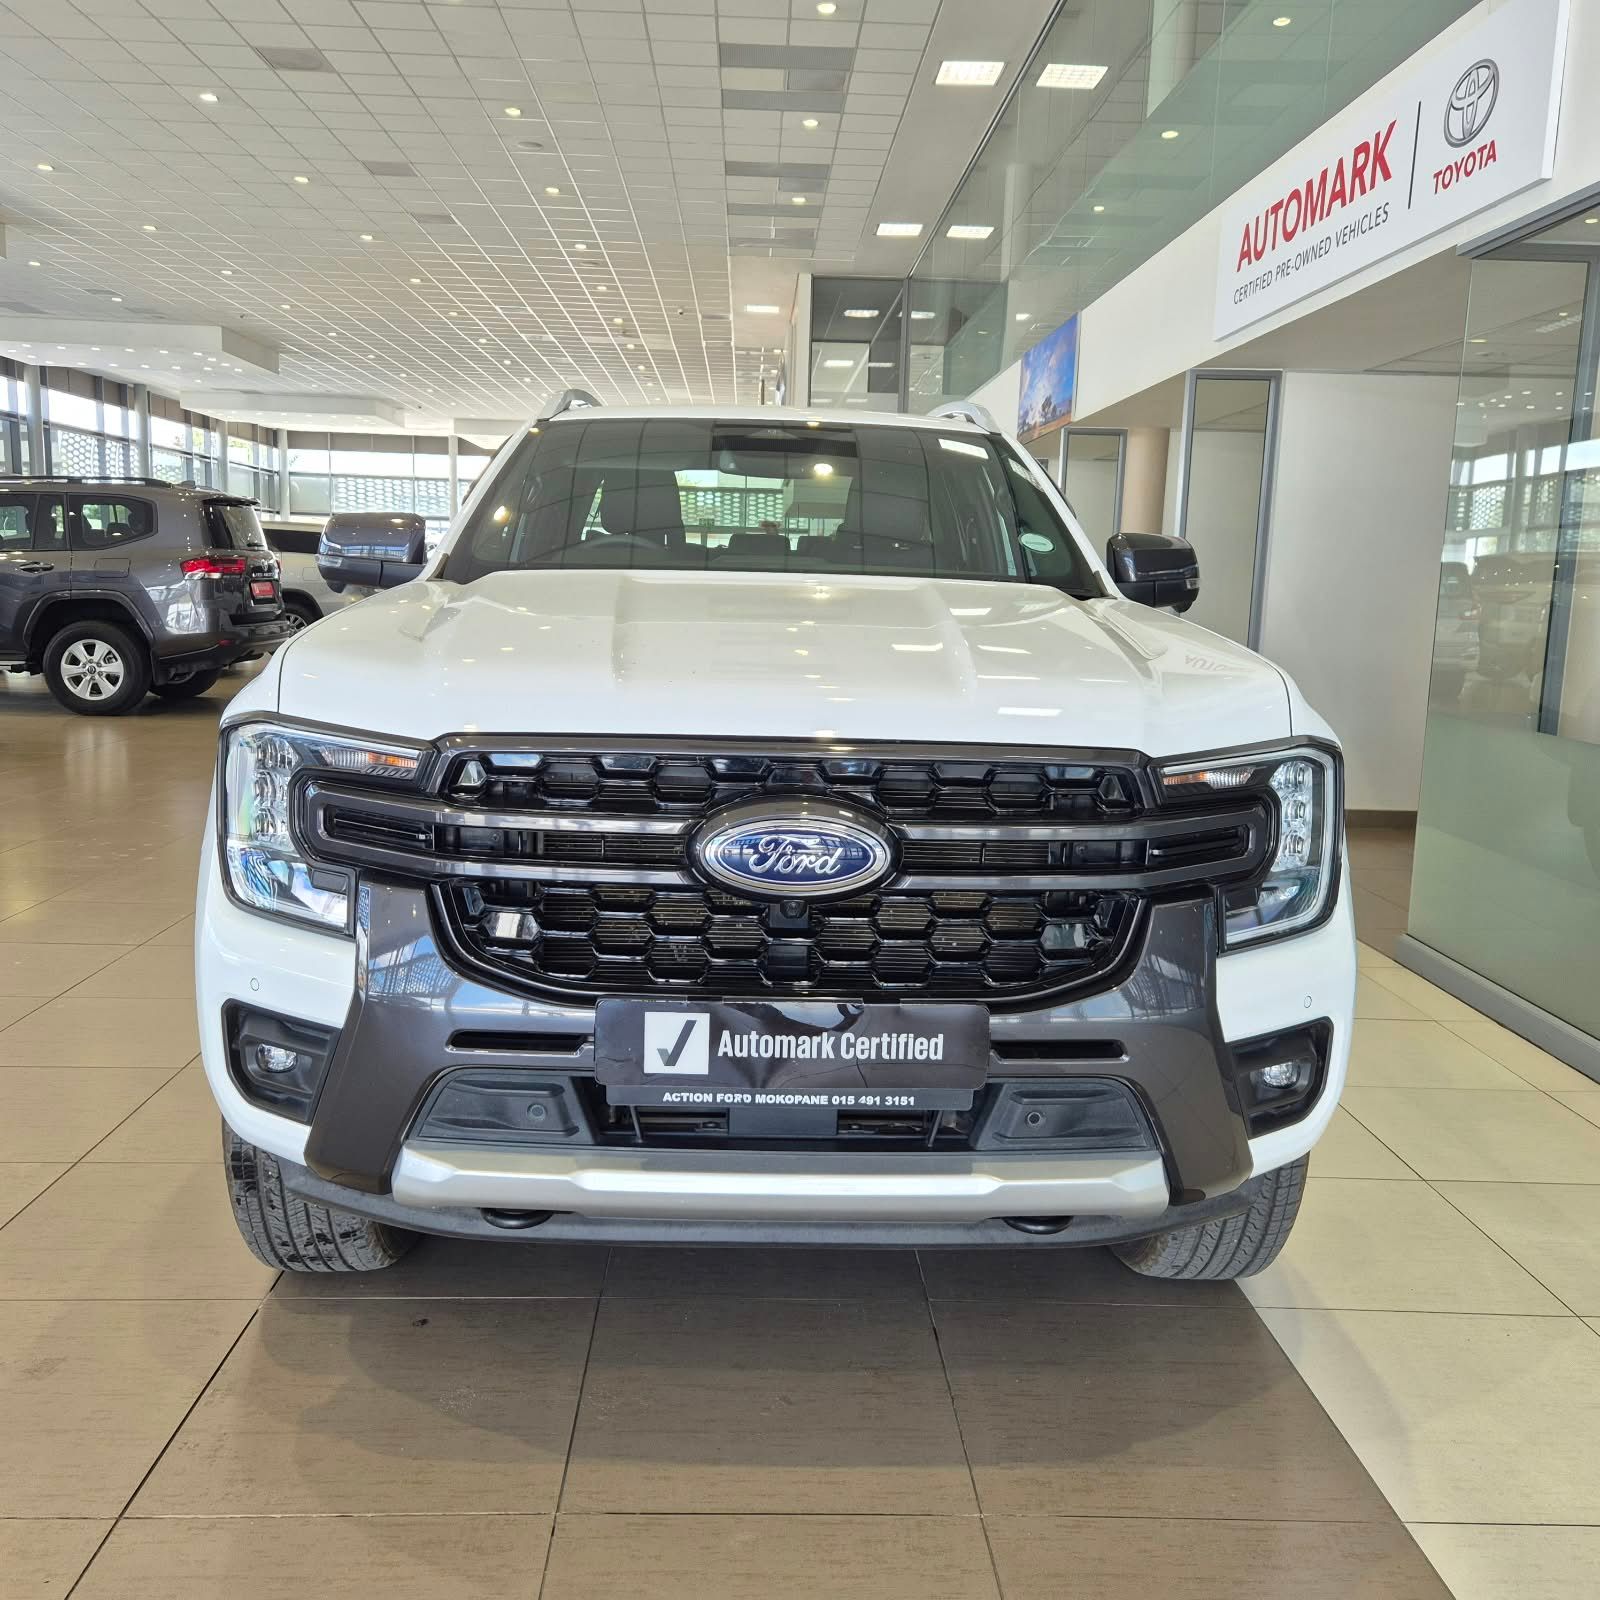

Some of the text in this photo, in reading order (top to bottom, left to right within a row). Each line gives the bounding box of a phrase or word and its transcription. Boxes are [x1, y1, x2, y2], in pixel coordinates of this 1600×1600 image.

[1433, 139, 1497, 195] TOYOTA
[1236, 119, 1397, 272] AUTOMARK
[1233, 202, 1390, 305] CERTIFIED PRE-OWNED VEHICLES
[748, 834, 844, 875] Ford
[717, 1029, 944, 1061] Automark Certified
[662, 1092, 916, 1107] ACTION FORD MOKOPANE 015 491 3151
